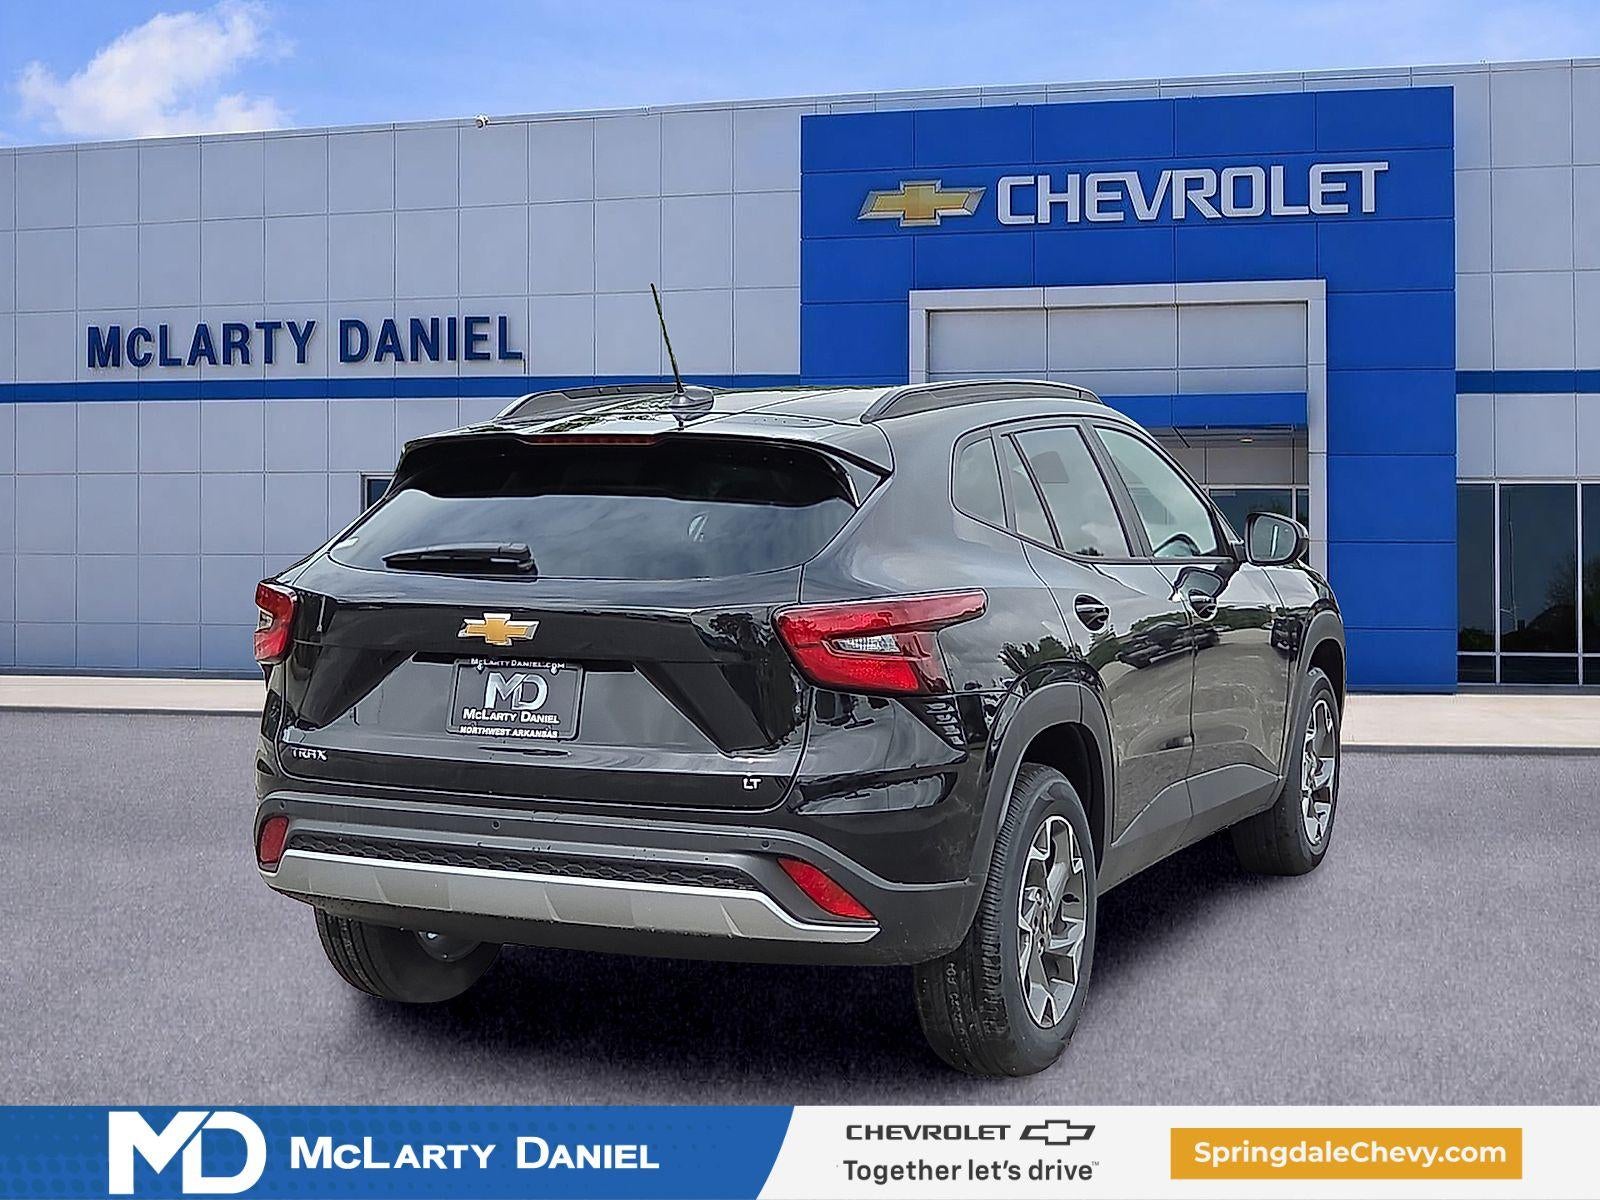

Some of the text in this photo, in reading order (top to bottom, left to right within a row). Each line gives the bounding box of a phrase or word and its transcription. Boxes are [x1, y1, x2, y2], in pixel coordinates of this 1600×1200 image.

[997, 161, 1389, 224] CHEVROLET
[87, 315, 524, 368] MCLARTY DANIEL
[484, 671, 549, 711] MD
[459, 725, 558, 739] NORTHWEST ARKANSAS
[742, 777, 762, 790] LT
